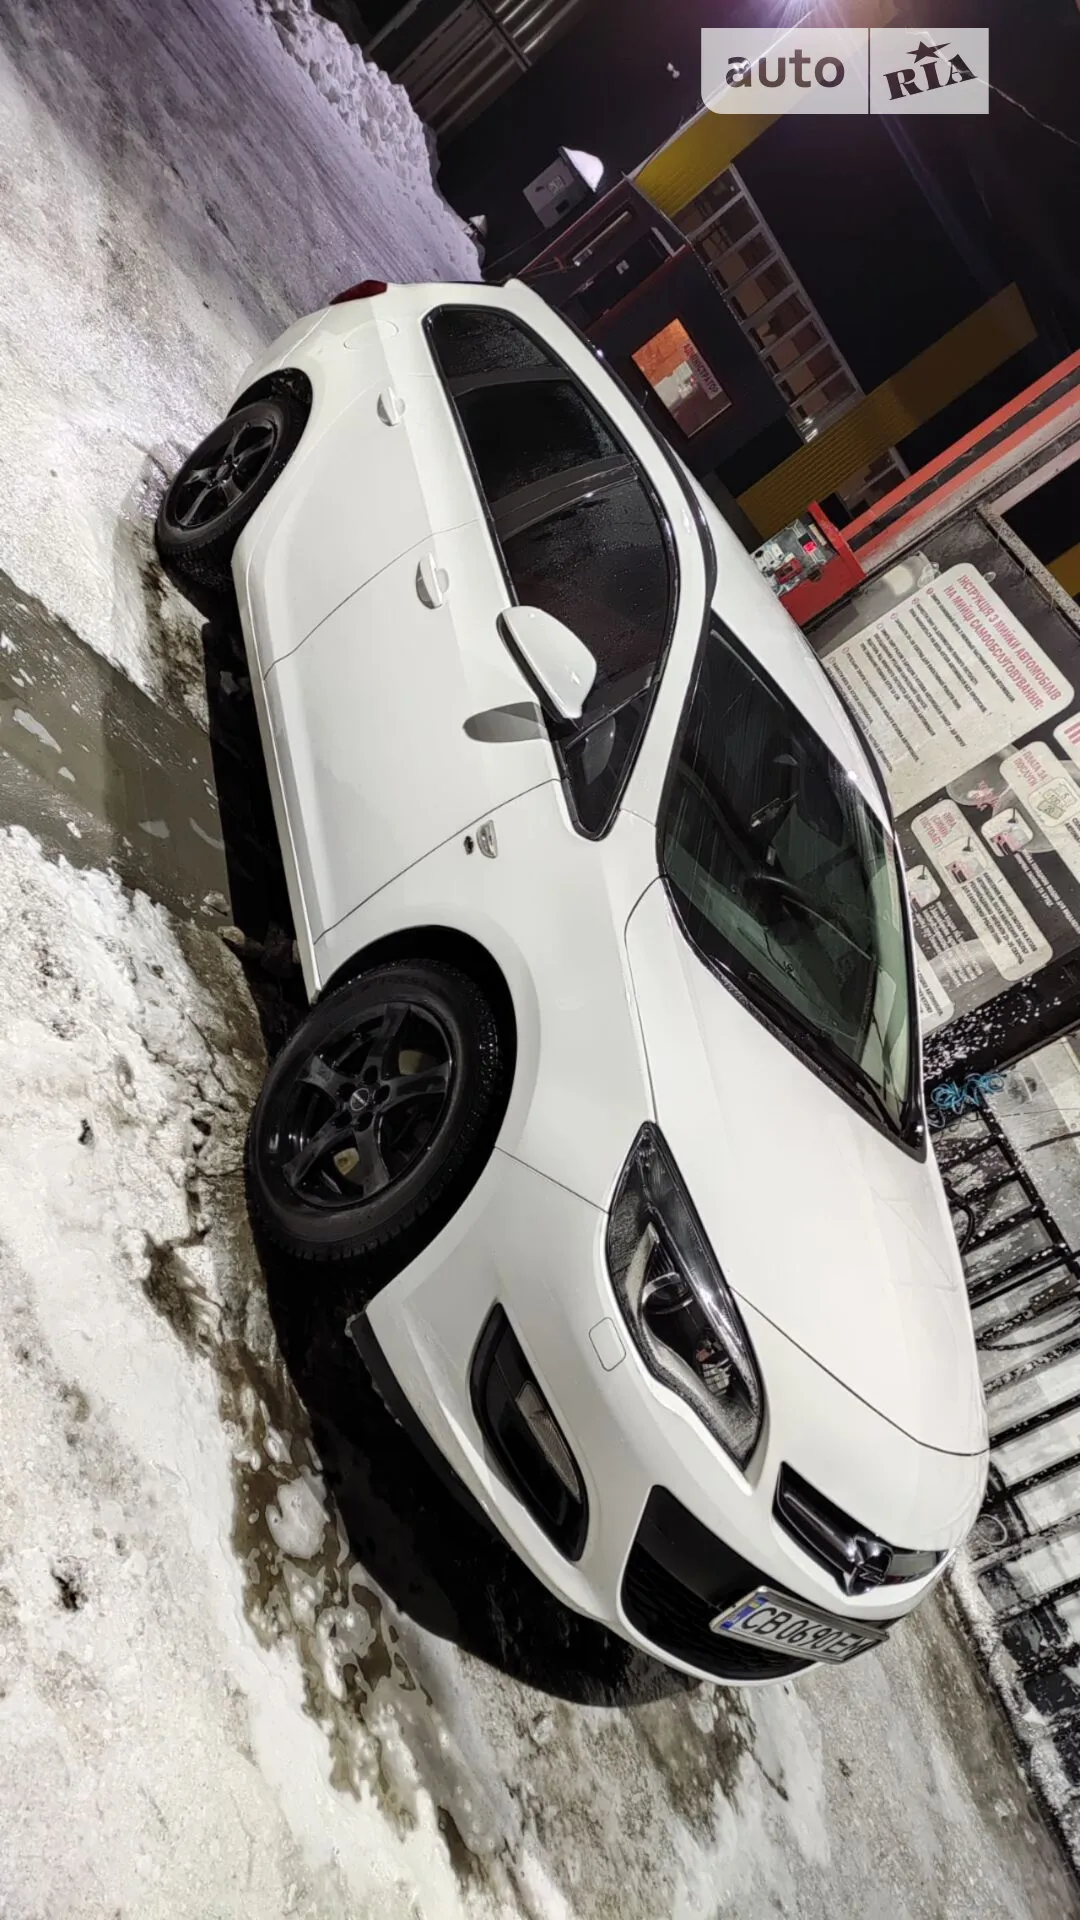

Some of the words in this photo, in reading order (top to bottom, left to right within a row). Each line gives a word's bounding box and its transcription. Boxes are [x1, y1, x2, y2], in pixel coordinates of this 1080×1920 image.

[942, 584, 958, 599] НА
[950, 593, 978, 623] МИЙЦІ
[956, 573, 994, 618] ІНСТРУКЦІЯ
[992, 617, 1022, 651] МИЙКИ
[1014, 645, 1062, 701] АВТОМОБІЛІВ
